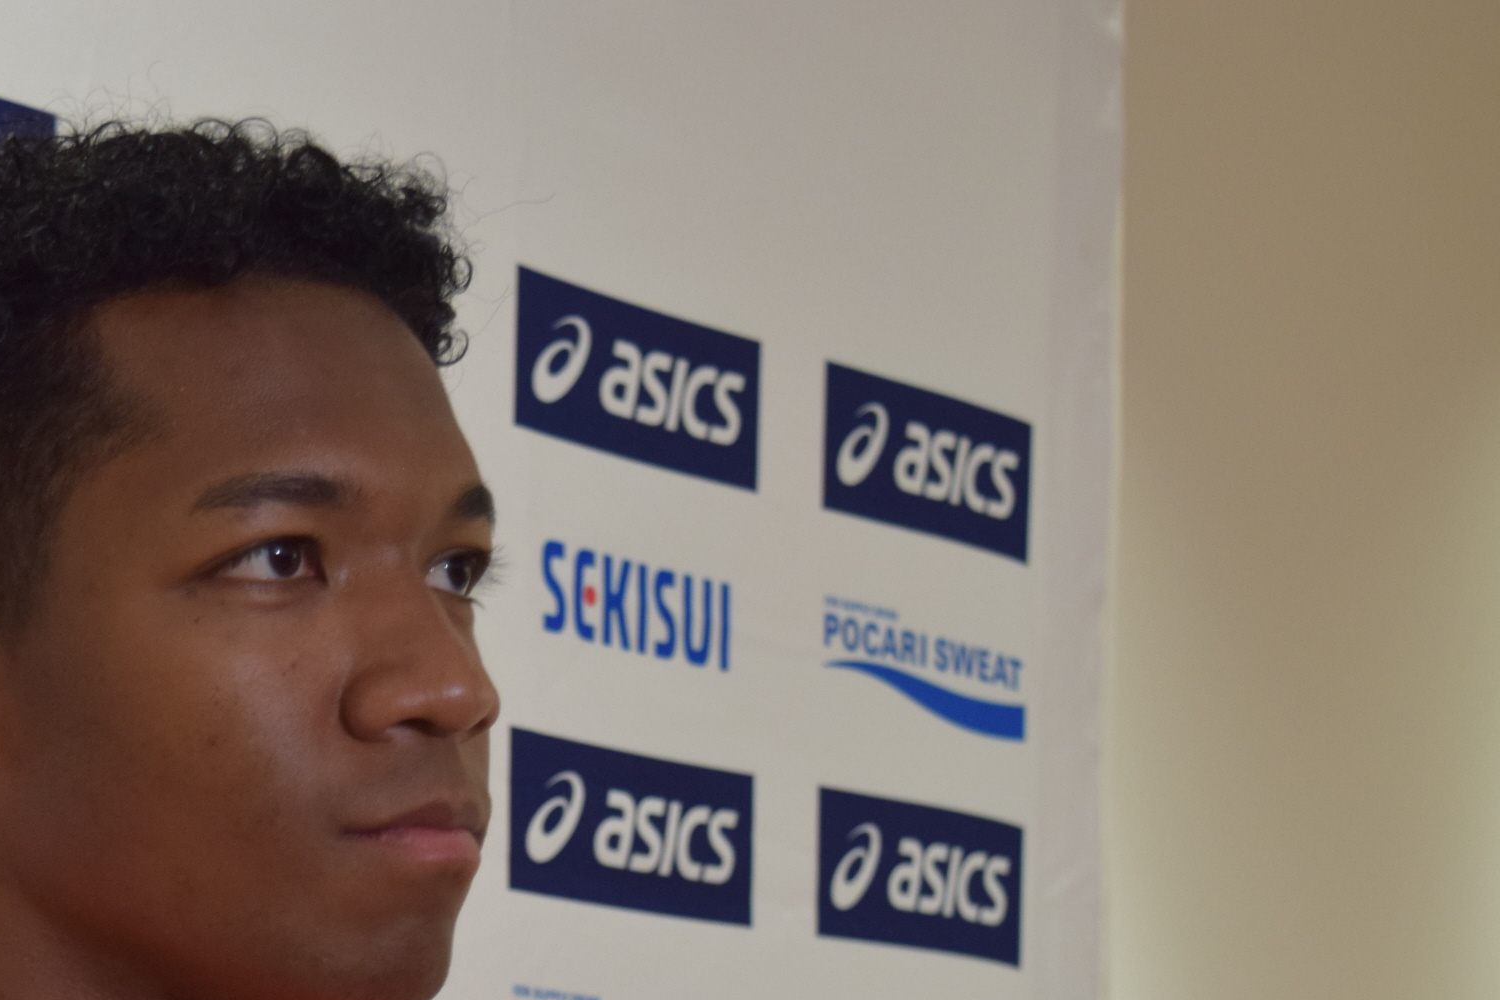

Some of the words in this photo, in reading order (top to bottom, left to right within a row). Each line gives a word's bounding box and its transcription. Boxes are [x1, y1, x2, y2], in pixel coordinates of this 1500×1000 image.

[600, 340, 746, 446] asics
[894, 422, 1019, 520] asics
[542, 540, 730, 671] SEKISUI
[823, 611, 928, 669] POCARI
[934, 634, 1022, 692] SWEAT
[594, 790, 738, 884] asics
[888, 838, 1010, 926] asics
